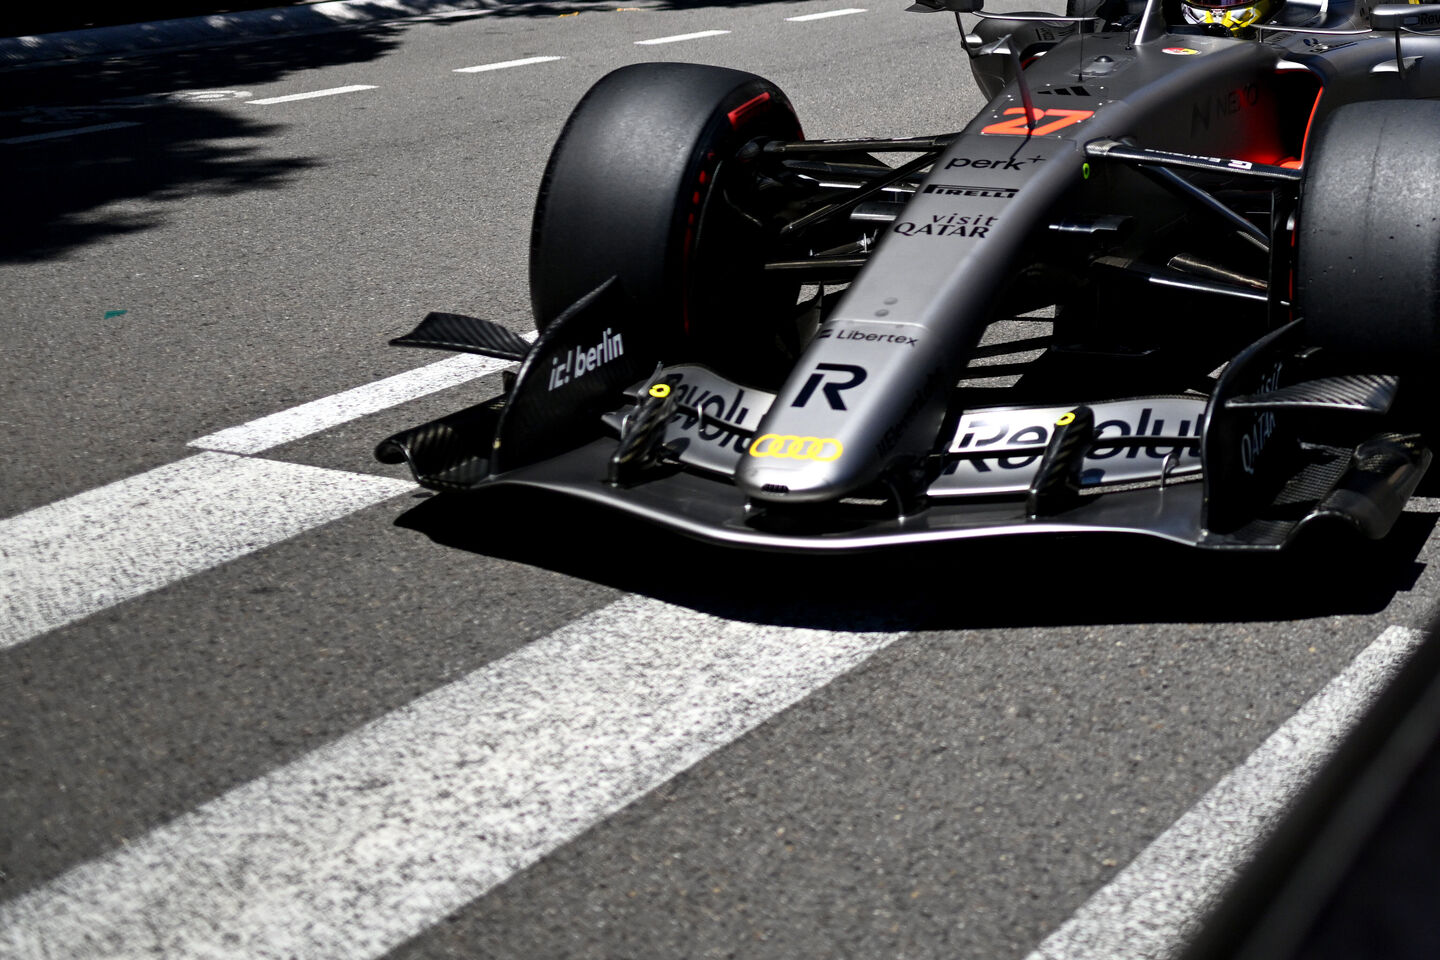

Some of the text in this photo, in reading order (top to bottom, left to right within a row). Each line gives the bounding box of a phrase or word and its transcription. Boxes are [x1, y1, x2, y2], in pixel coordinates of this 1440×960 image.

[981, 107, 1094, 136] 27
[923, 184, 1020, 199] PIRELLI
[932, 213, 999, 226] visit
[894, 222, 990, 239] QATAR
[836, 329, 919, 347] Libertex
[548, 327, 623, 391] ic! berlin
